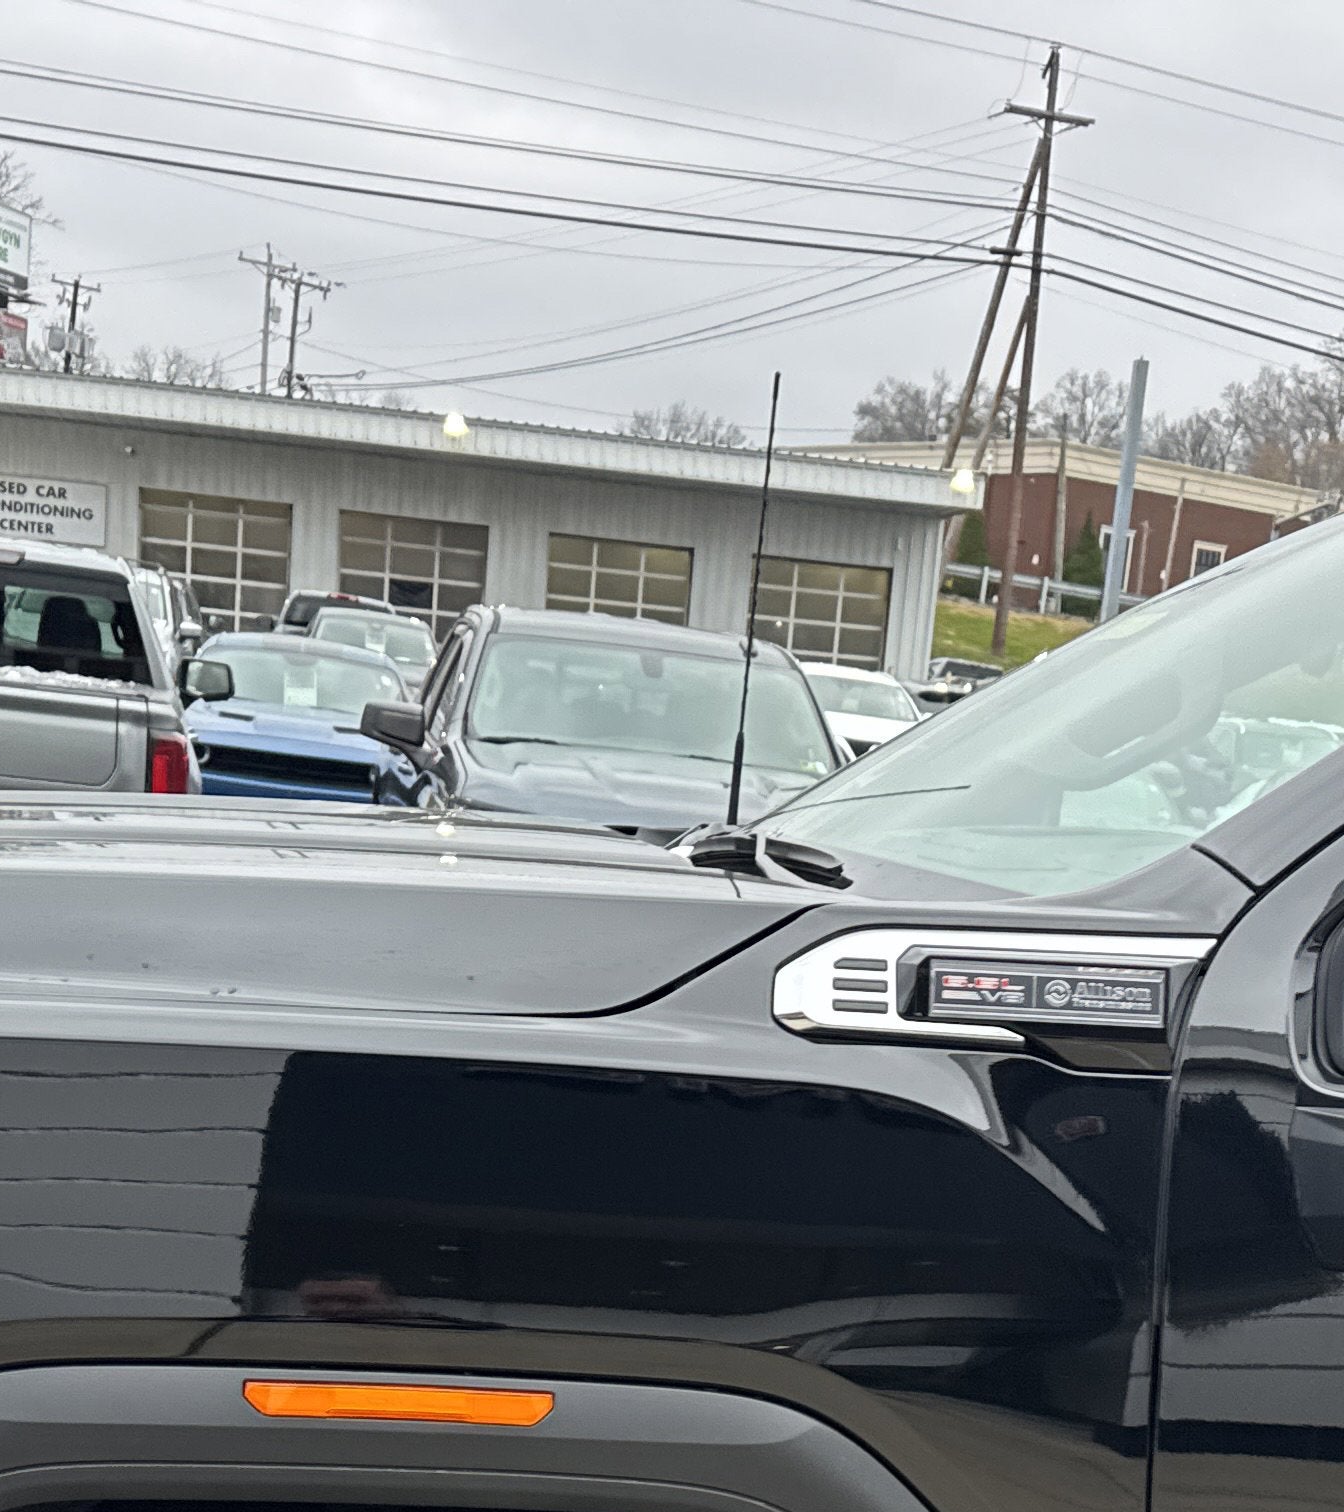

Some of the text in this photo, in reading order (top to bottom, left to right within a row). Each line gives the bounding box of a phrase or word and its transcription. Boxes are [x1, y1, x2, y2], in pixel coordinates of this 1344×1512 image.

[35, 485, 67, 500] CAR
[0, 518, 54, 535] CENTER
[1072, 981, 1152, 1001] Allison
